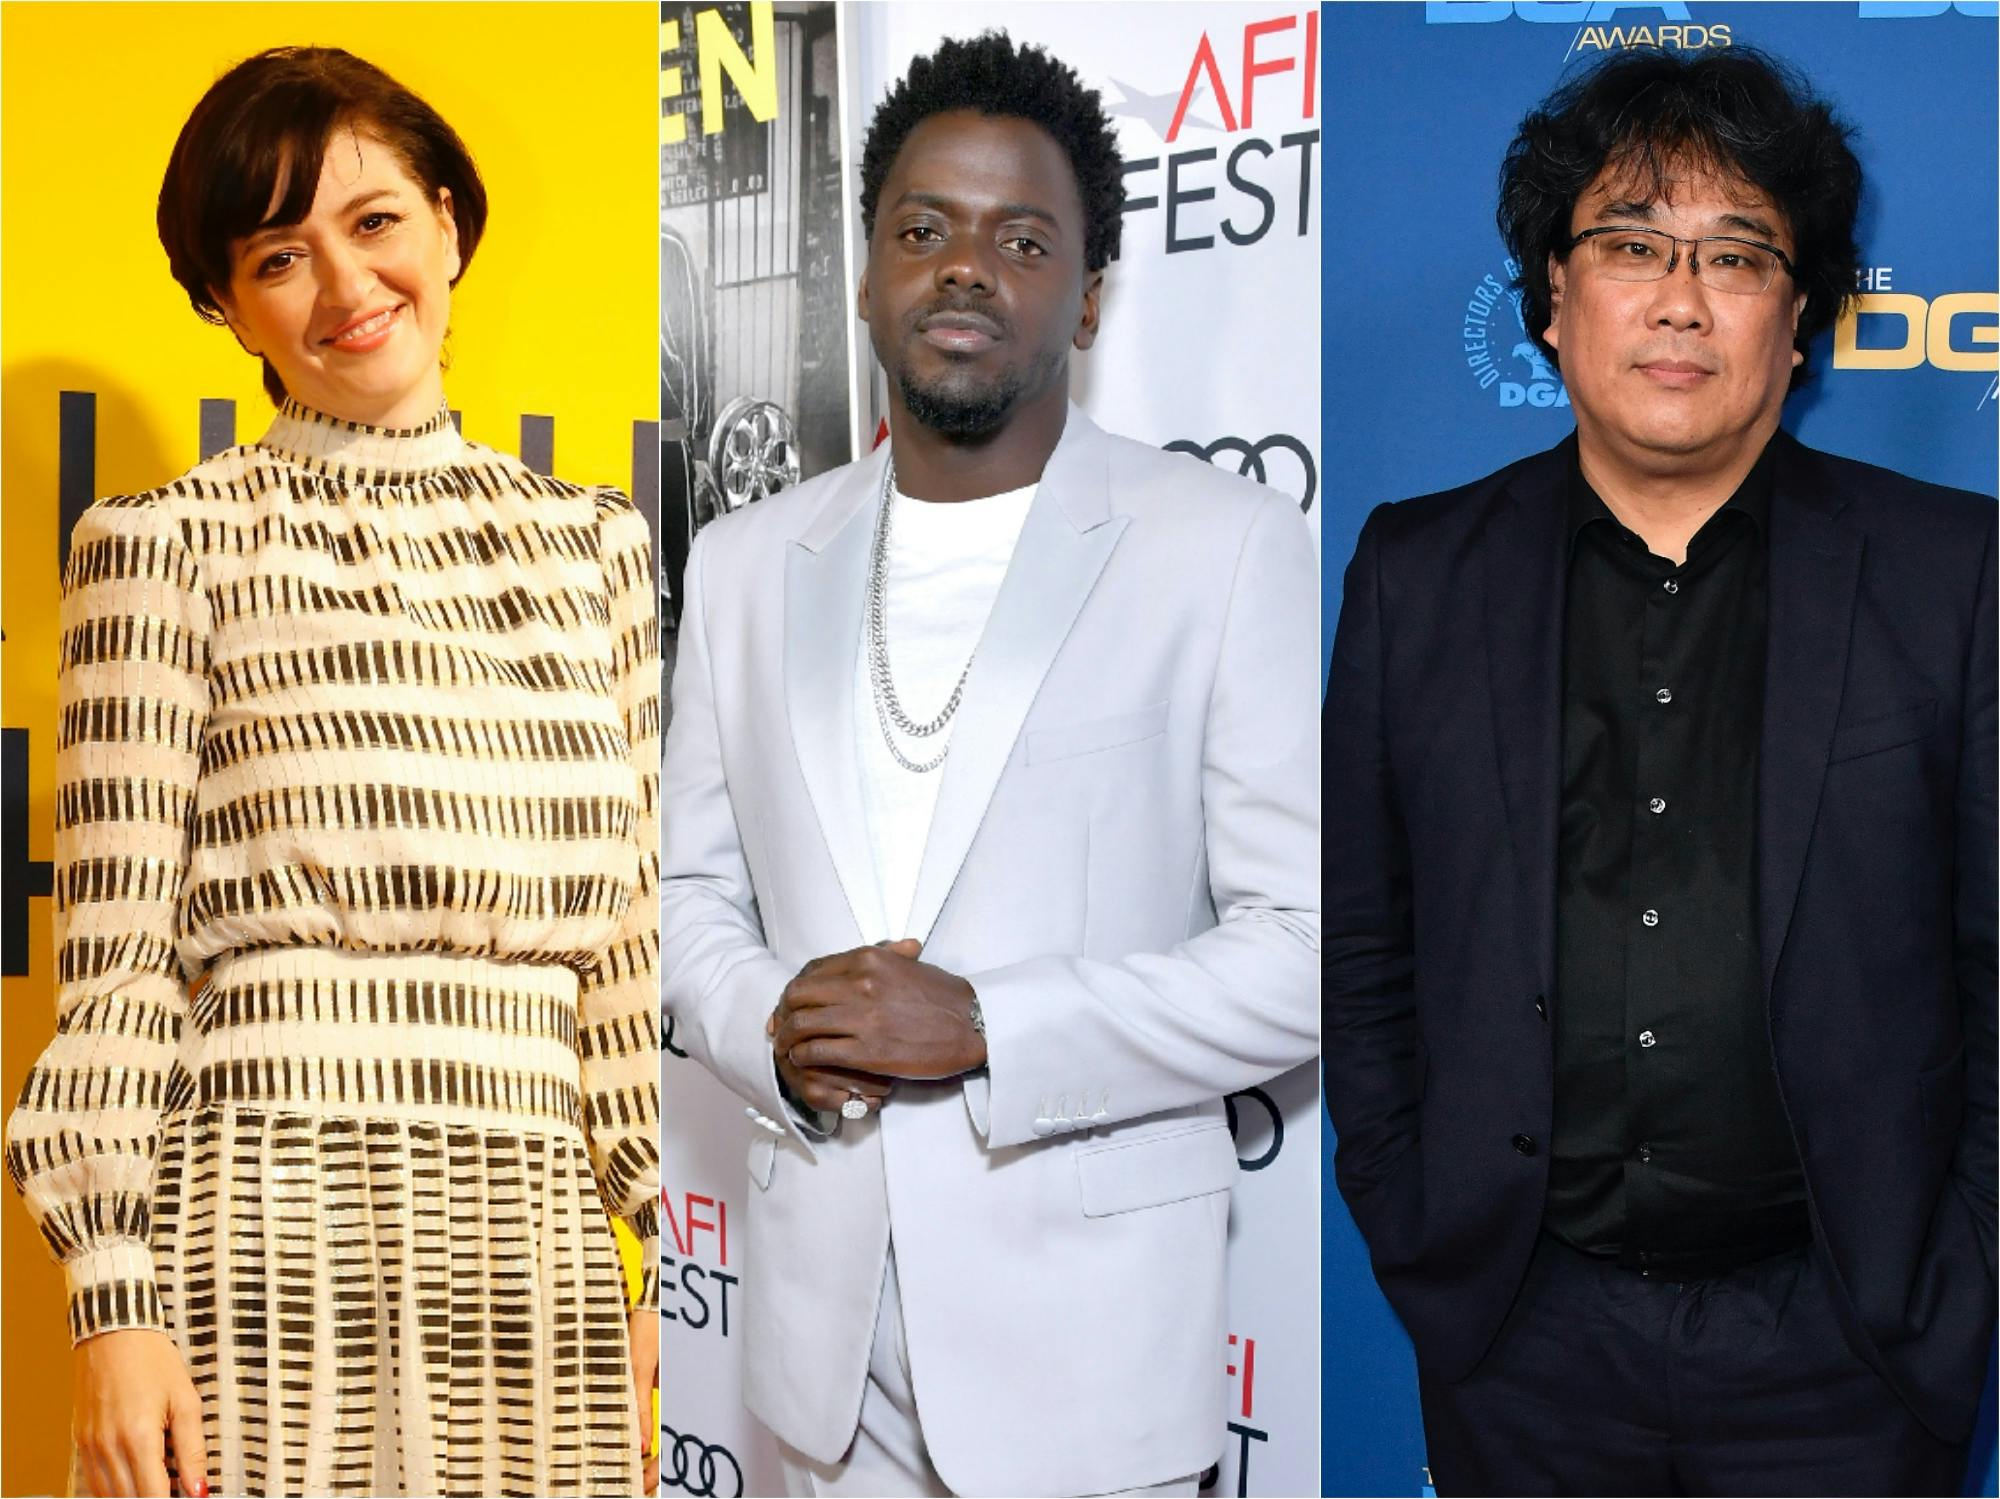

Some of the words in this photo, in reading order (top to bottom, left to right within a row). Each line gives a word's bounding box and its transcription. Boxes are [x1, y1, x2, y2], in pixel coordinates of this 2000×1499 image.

[1164, 10, 1319, 143] AFI
[1110, 128, 1320, 262] FEST
[1463, 273, 1504, 389] DIRECTORS
